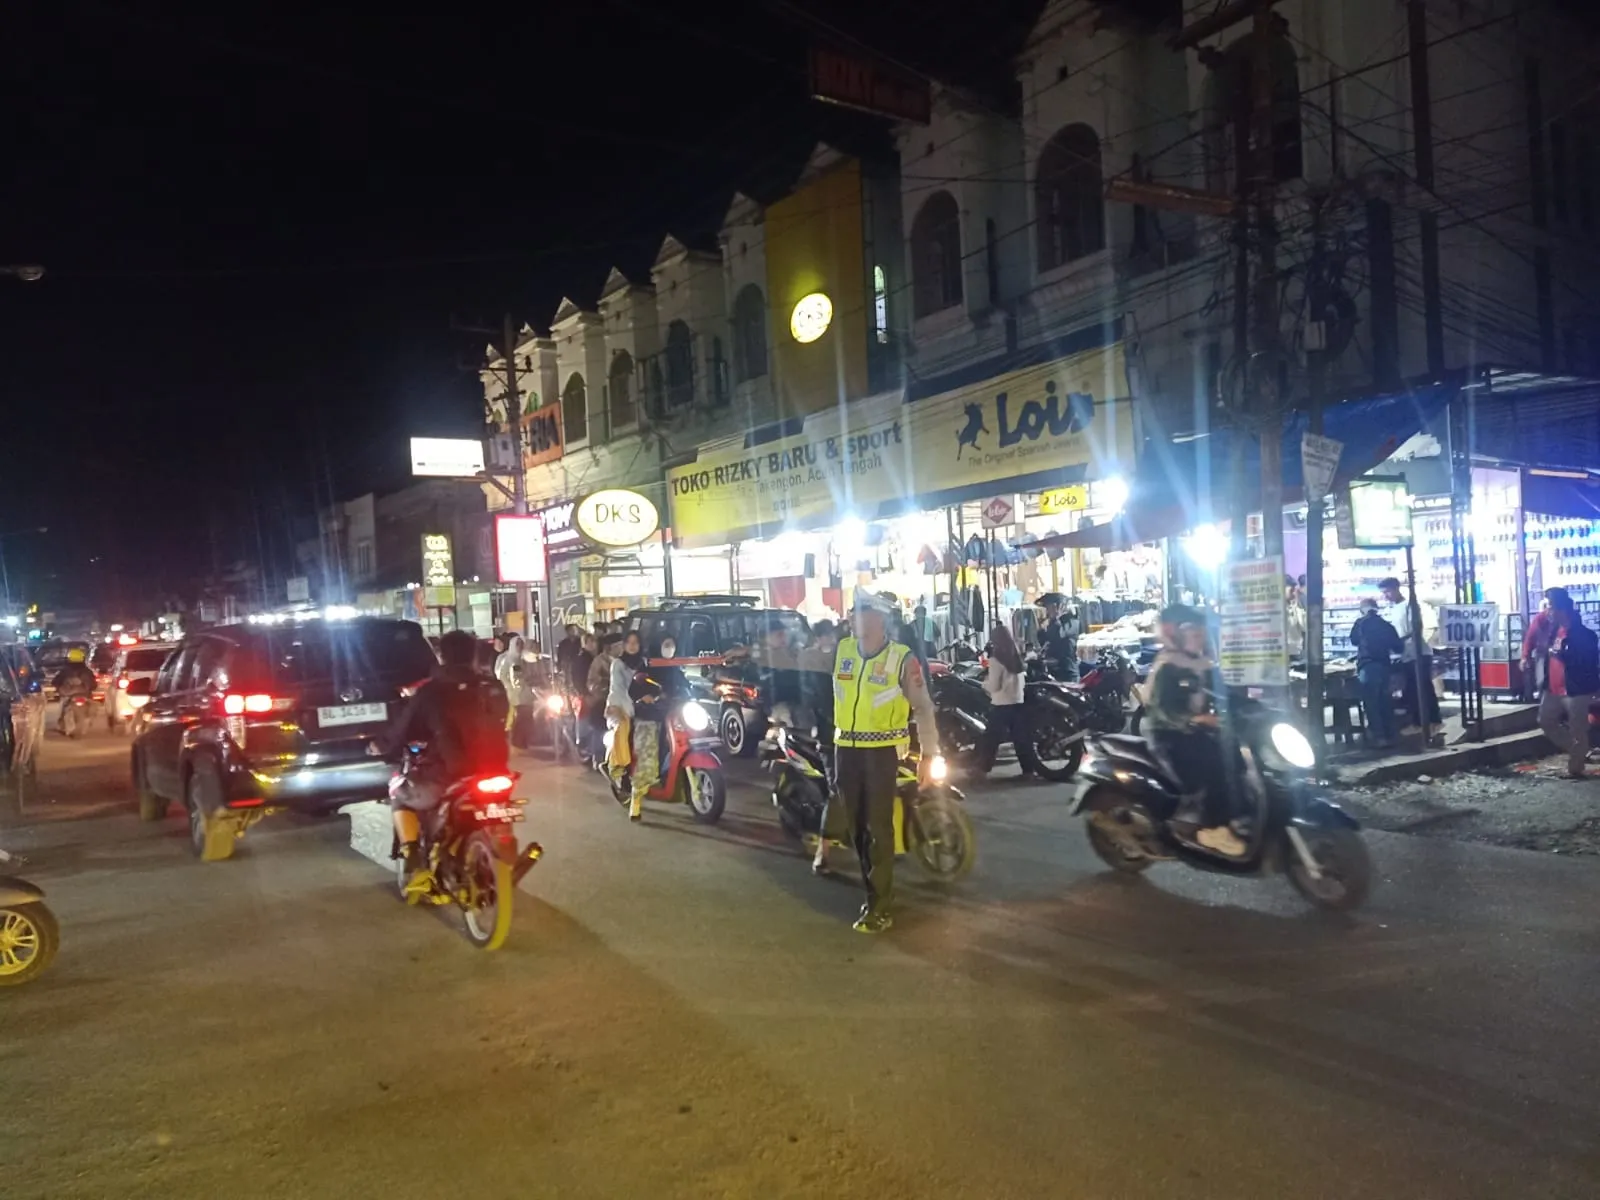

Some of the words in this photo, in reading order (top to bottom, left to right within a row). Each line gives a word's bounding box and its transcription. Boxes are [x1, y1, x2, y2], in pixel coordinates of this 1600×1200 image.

[996, 381, 1095, 449] Lois
[671, 470, 709, 496] TOKO
[714, 456, 763, 486] RIZKY
[768, 442, 817, 474] BARU
[825, 437, 838, 459] &
[847, 421, 903, 457] sport
[1054, 492, 1078, 508] Lois
[595, 503, 641, 524] DKS
[1447, 609, 1489, 620] PROMO
[1445, 622, 1475, 642] 100
[1480, 622, 1490, 642] K
